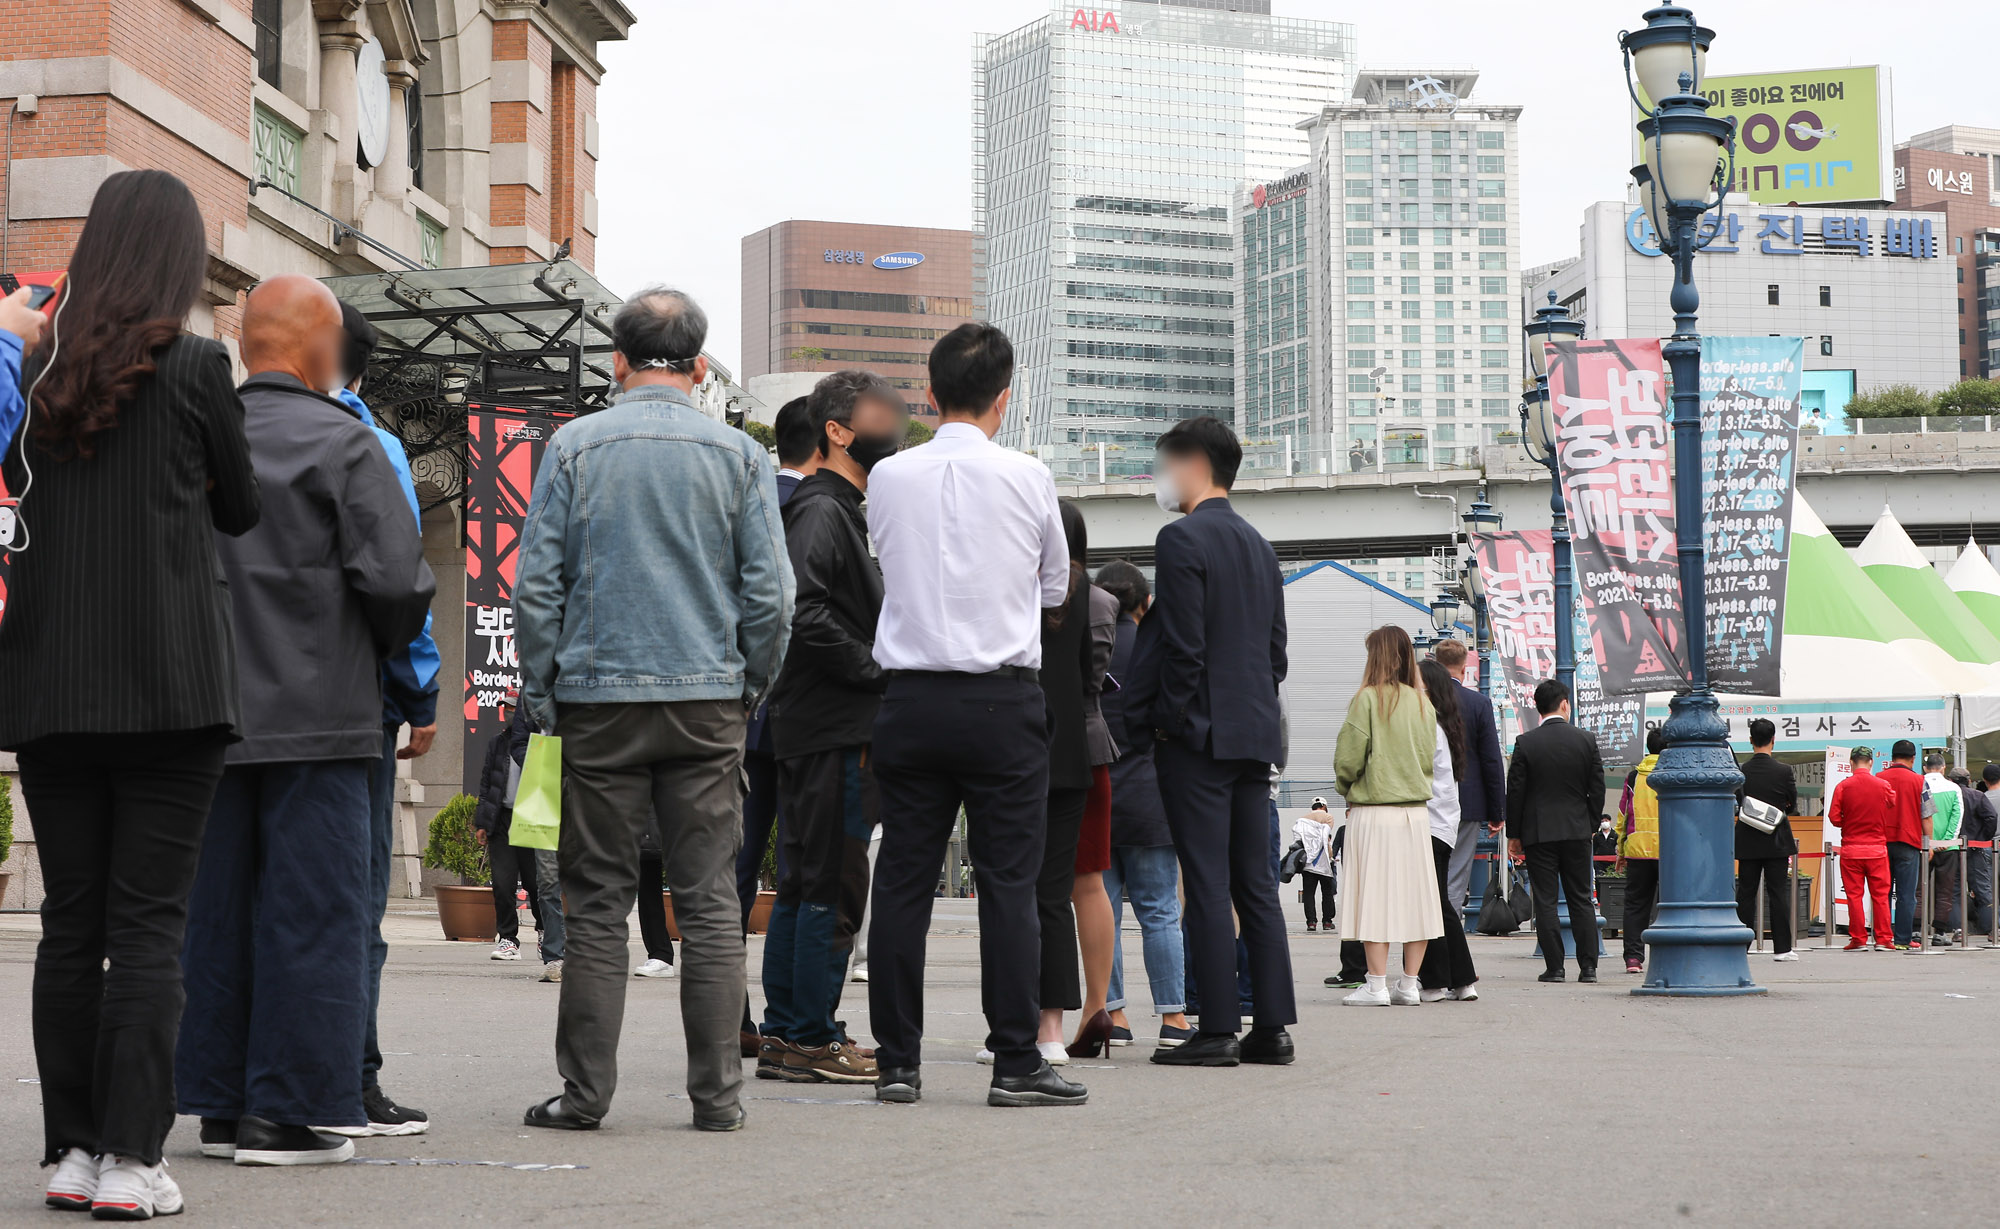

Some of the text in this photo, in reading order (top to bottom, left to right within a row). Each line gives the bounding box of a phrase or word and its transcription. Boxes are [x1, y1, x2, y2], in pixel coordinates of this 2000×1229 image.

[1070, 8, 1120, 33] AIA
[1124, 23, 1143, 36] 생명
[1730, 86, 1784, 108] 좋아요
[1790, 81, 1844, 103] 진에어
[1927, 168, 1973, 195] 에스원
[1698, 212, 1933, 258] 한진택배
[823, 248, 865, 265] 삼성생명
[880, 255, 918, 265] SAMSUNG
[1557, 393, 1621, 541] 사이트
[1607, 366, 1674, 563] 보더리스
[1765, 705, 1778, 713] 19
